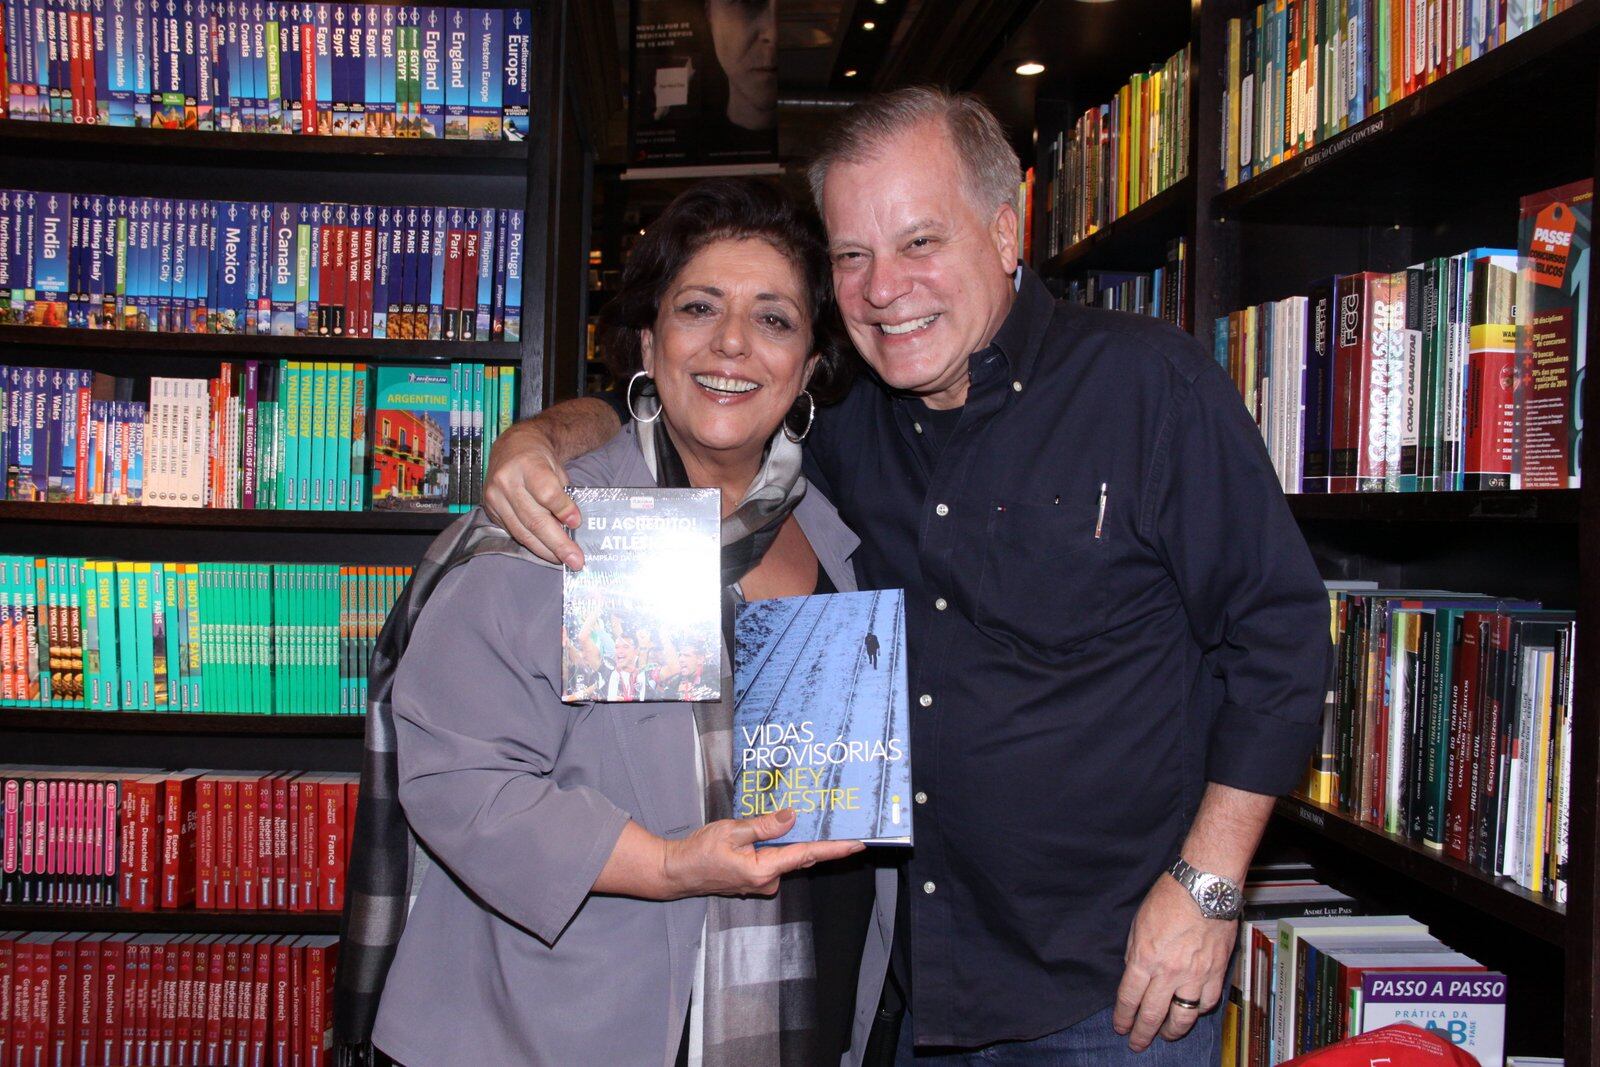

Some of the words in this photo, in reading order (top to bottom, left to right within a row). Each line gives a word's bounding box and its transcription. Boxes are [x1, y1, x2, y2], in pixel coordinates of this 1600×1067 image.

[94, 17, 104, 50] Bulgaria
[115, 15, 124, 56] Caribbean
[136, 18, 144, 52] Northern
[170, 19, 180, 52] central
[185, 21, 193, 54] CHICAGO
[199, 24, 208, 54] China's
[241, 23, 250, 57] Croatia
[255, 24, 264, 58] Croatia
[317, 27, 328, 56] Egypt
[334, 28, 344, 57] Egypt
[350, 29, 361, 57] Egypt
[367, 29, 377, 57] Egypt
[423, 31, 440, 90] England
[450, 32, 465, 88] England
[482, 34, 491, 69] Western
[505, 35, 521, 85] Europe
[117, 58, 125, 87] Islands
[137, 54, 145, 89] California
[171, 53, 179, 90] america
[200, 56, 210, 101] Southwest
[480, 72, 491, 102] Europe
[1351, 120, 1384, 144] CONCURSO
[0, 216, 9, 260] Northeast
[44, 217, 60, 259] India
[92, 219, 101, 249] Hiking
[105, 219, 115, 256] Hungary
[128, 222, 137, 246] Kenya
[141, 222, 149, 248] Korea
[163, 222, 171, 241] New
[176, 223, 185, 242] New
[434, 231, 444, 256] Paris
[1534, 228, 1572, 246] PASSE
[90, 261, 101, 280] Italy
[93, 251, 100, 259] in
[225, 227, 240, 284] Mexico
[278, 228, 292, 284] Canada
[298, 248, 307, 286] Canada
[482, 231, 492, 278] Philippines
[508, 233, 521, 279] Portugal
[1530, 250, 1567, 264] CONCURSOS
[0, 262, 9, 284] India
[160, 264, 169, 282] City
[175, 265, 184, 283] City
[1345, 294, 1358, 346] FCC
[1371, 301, 1390, 387] PASSAR
[1408, 334, 1416, 396] GABARITAR
[11, 391, 19, 426] Venezuela
[36, 393, 46, 428] Victoria
[52, 396, 61, 420] Wales
[287, 375, 297, 437] ARGENTINA
[300, 376, 310, 437] ARGENTINA
[314, 376, 324, 438] ARGENTINA
[327, 376, 337, 438] ARGENTINA
[388, 394, 448, 405] ARGENTINE
[1368, 389, 1386, 462] COMO
[246, 458, 253, 466] OF
[588, 517, 606, 530] EU
[611, 516, 697, 530] ACREDITO!
[100, 578, 110, 608] PARIS
[742, 721, 814, 747] VIDAS
[1449, 736, 1456, 749] DO
[1487, 704, 1498, 792] Esquematizado
[742, 735, 903, 770] PROVISÓRIAS
[1457, 733, 1467, 788] CONCURSOS
[742, 766, 826, 793] EDNEY
[1470, 762, 1478, 811] PROCESSO
[740, 786, 860, 818] SILVESTRE
[58, 975, 67, 1024] Deutschland
[1372, 980, 1427, 996] PASSO
[1430, 982, 1444, 996] A
[1448, 982, 1504, 998] PASSO
[1394, 1009, 1446, 1018] PRÁTICA
[1453, 1010, 1468, 1018] DA
